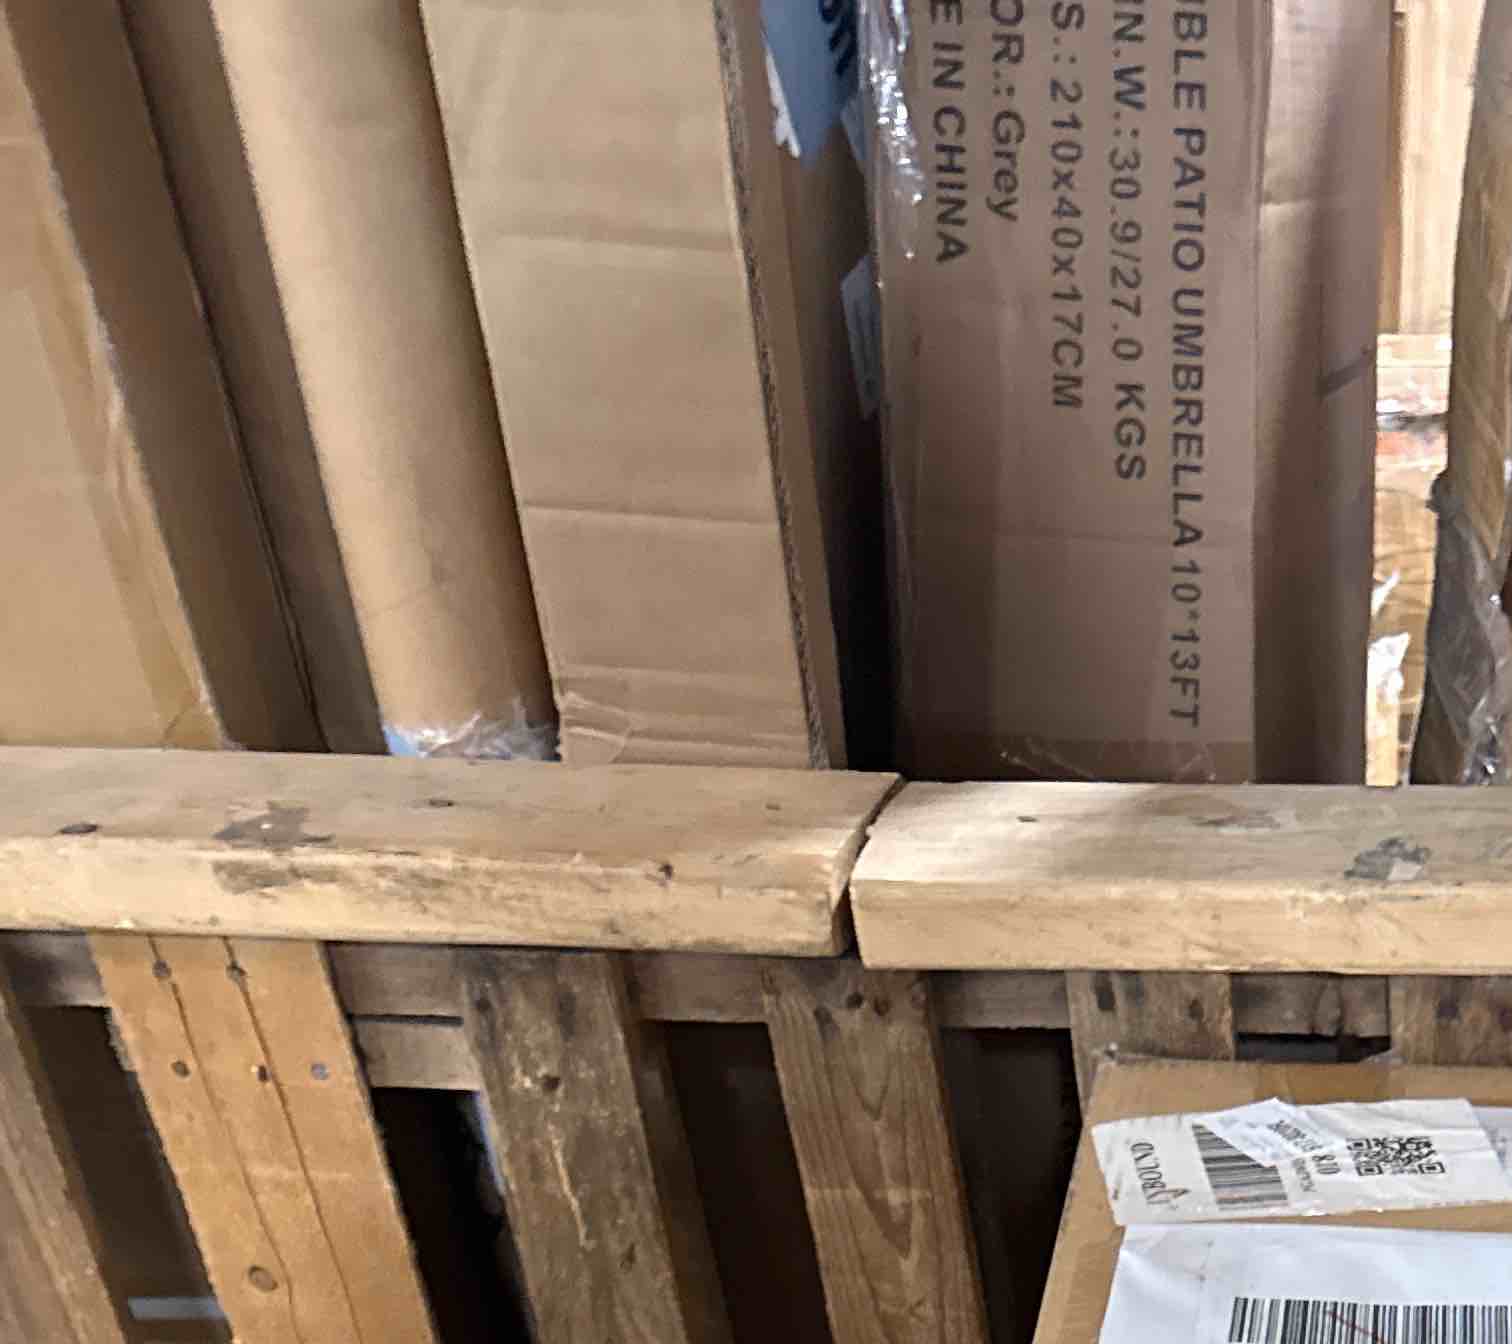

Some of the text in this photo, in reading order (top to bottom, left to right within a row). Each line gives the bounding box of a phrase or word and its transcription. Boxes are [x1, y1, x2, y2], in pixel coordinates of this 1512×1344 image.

[931, 41, 964, 90] IN
[1172, 0, 1208, 111] BLE
[932, 105, 970, 264] CHINA
[986, 109, 1026, 223] Grey
[1171, 126, 1208, 273] PATIO
[1049, 79, 1086, 410] 210x40x17CM
[1113, 381, 1147, 481] KGS
[1170, 287, 1206, 549] UMBRELLA
